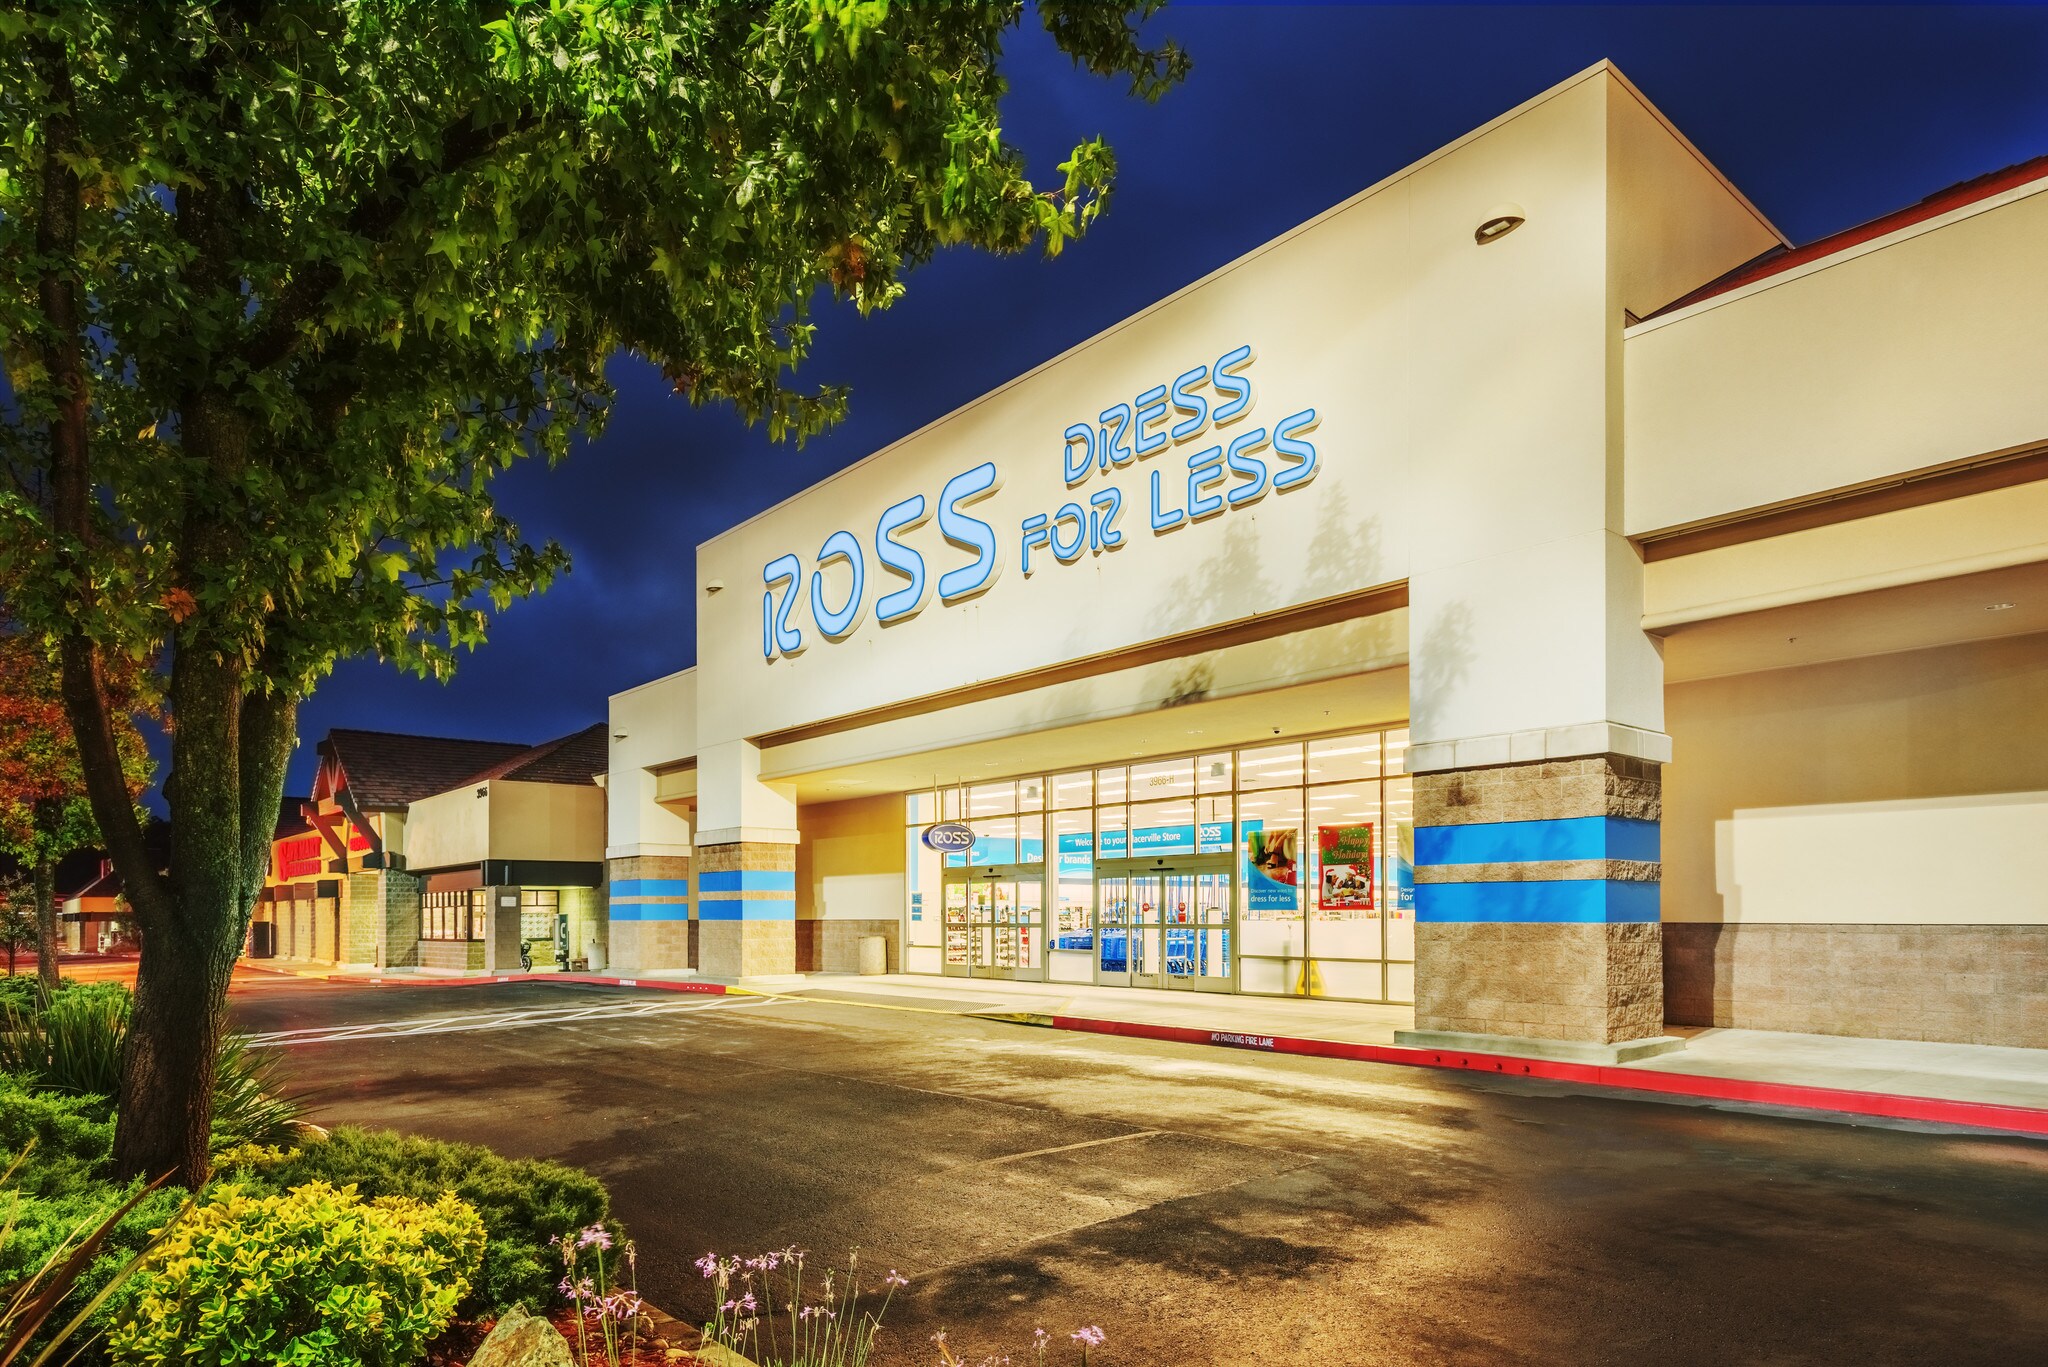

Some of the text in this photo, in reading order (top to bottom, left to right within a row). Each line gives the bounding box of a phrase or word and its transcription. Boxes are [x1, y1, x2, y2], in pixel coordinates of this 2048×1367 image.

[1063, 344, 1253, 486] DRESS
[1020, 407, 1318, 575] FOR LESS
[762, 461, 1000, 660] ROSS
[1150, 775, 1175, 787] 3966-H
[934, 831, 970, 844] ROSS
[1103, 837, 1111, 845] to
[1112, 837, 1127, 847] your
[1131, 833, 1161, 844] lacerville
[1162, 832, 1181, 841] Store
[1341, 835, 1368, 847] Happy
[1064, 854, 1091, 865] brands
[1400, 892, 1414, 901] for
[1211, 1033, 1274, 1047] NO PARKING FIRE LANE
